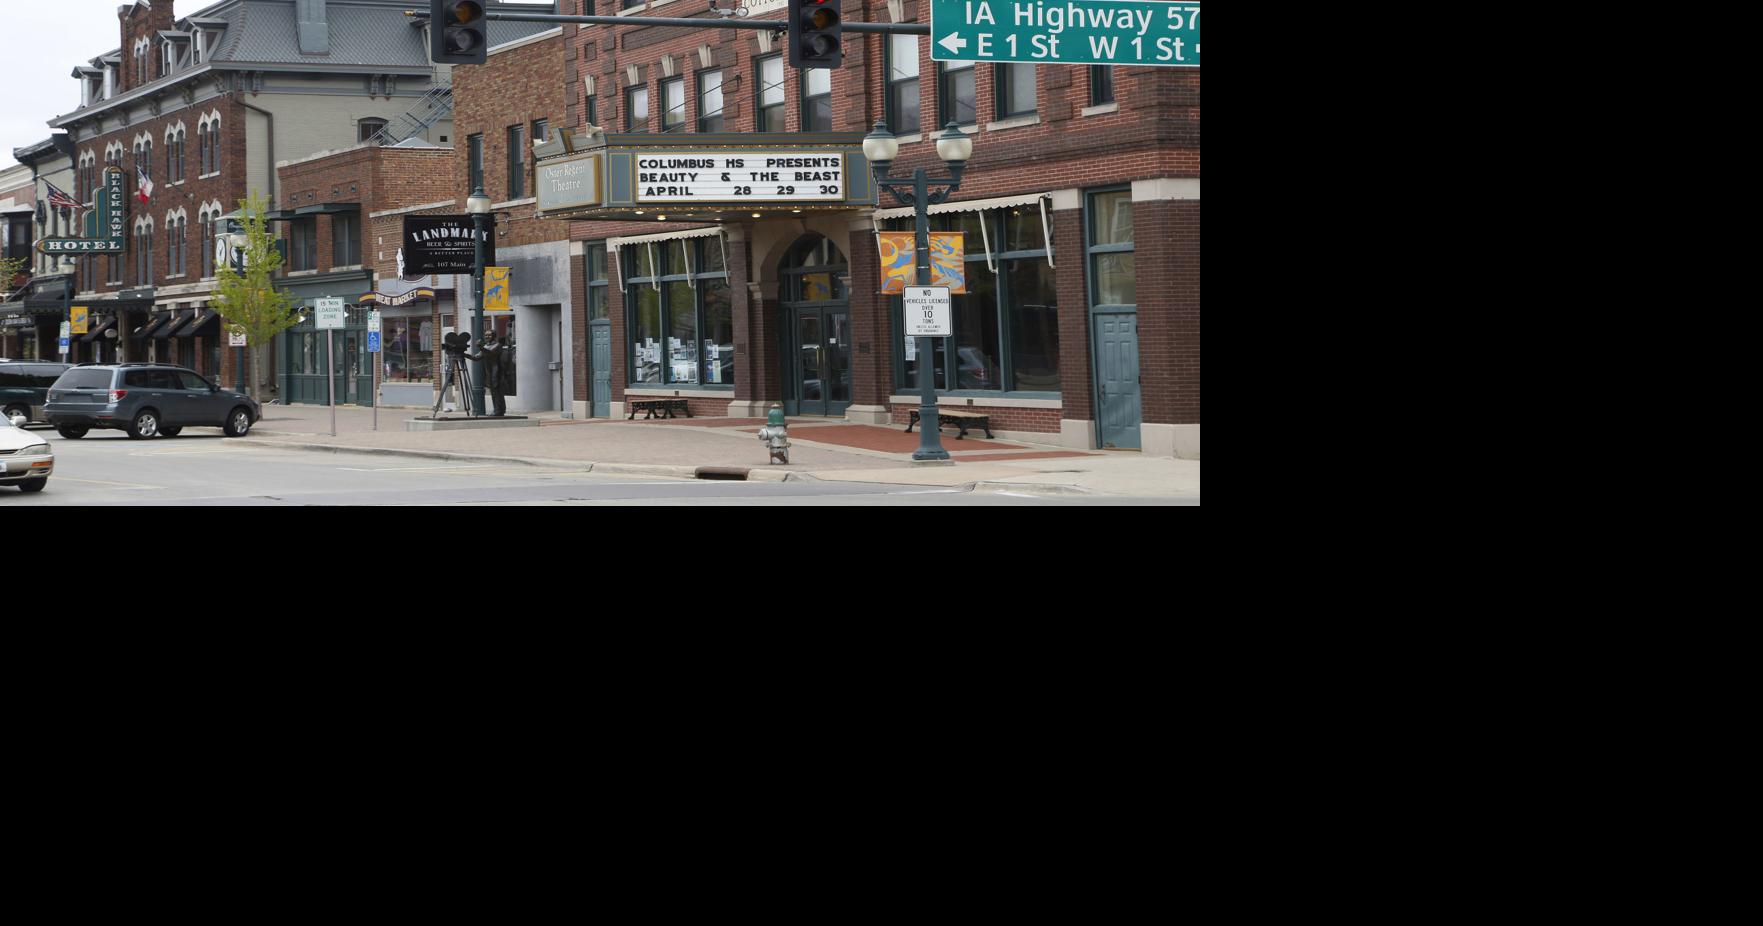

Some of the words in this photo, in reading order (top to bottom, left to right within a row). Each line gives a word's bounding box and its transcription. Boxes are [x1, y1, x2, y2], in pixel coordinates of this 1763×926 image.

[966, 1, 995, 25] IA
[1014, 1, 1153, 35] Highway
[1167, 6, 1200, 30] 57
[978, 33, 993, 57] E
[1005, 34, 1017, 57] 1
[1031, 33, 1060, 58] St
[1089, 36, 1118, 59] W
[1130, 37, 1142, 60] 1
[1156, 37, 1185, 61] St
[639, 158, 715, 169] COLUMBUS
[726, 158, 745, 168] HS
[766, 157, 840, 168] PRESENTS
[640, 172, 698, 183] BEAUTY
[721, 172, 731, 182] &
[750, 171, 780, 182] THE
[794, 171, 841, 182] BEAST
[111, 173, 121, 207] BLACK
[551, 179, 581, 192] Theatre
[645, 186, 694, 197] APRIL
[733, 185, 752, 196] 28
[777, 185, 795, 195] 29
[820, 184, 839, 195] 30
[111, 210, 121, 237] HAWK
[48, 241, 120, 250] HOTEL
[924, 310, 933, 318] 10
